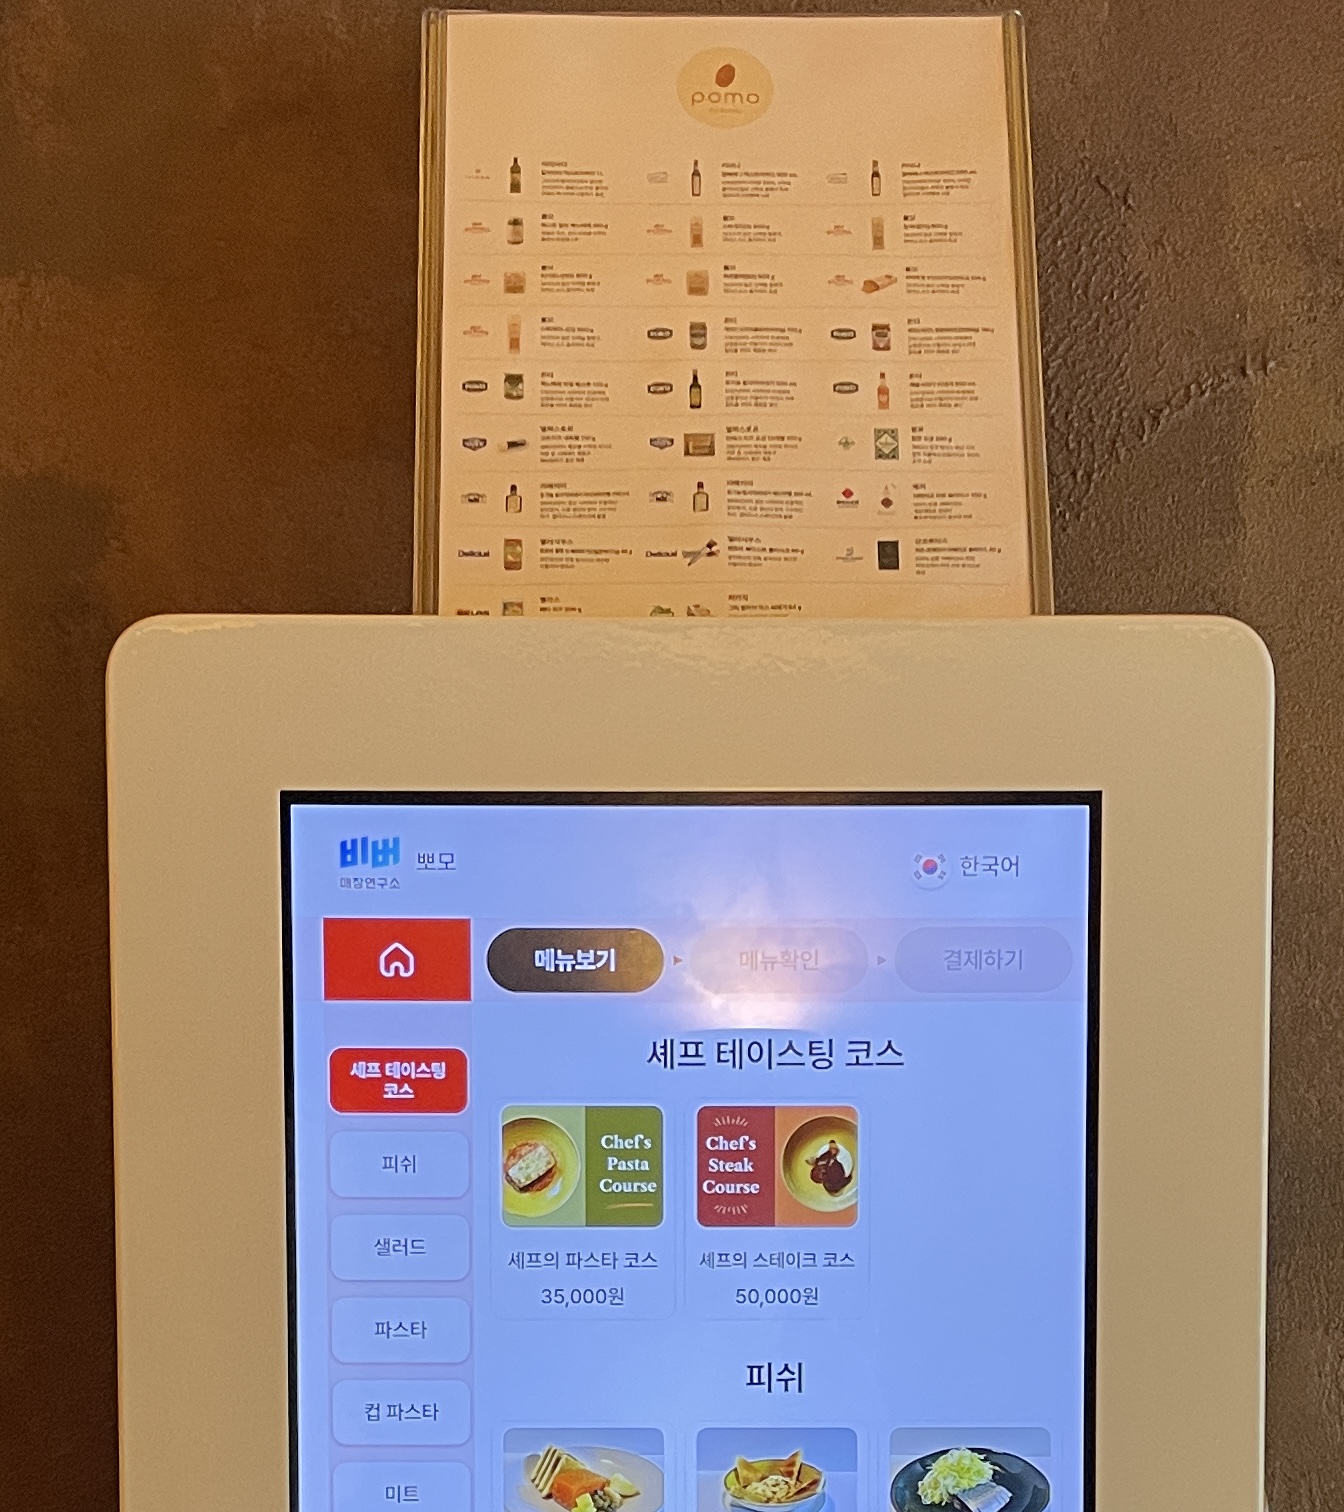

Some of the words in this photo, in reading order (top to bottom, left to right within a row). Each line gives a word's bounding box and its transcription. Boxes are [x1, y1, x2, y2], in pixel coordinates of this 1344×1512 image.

[691, 91, 760, 106] pomo
[339, 836, 401, 868] 비버
[416, 852, 457, 871] 뽀모
[960, 854, 1020, 879] 한국어
[533, 947, 616, 973] 메뉴보기
[739, 947, 820, 973] 메뉴확인
[943, 947, 1024, 973] 결제하기
[716, 1036, 835, 1072] 테이스팅
[845, 1039, 905, 1069] 코스
[385, 1061, 447, 1080] 테이스팅
[383, 1083, 415, 1099] 코스
[601, 1134, 652, 1150] Chef's
[705, 1136, 757, 1152] Chef's
[381, 1153, 418, 1175] 피쉬
[607, 1156, 650, 1172] Pasta
[708, 1158, 754, 1173] Steak
[599, 1178, 657, 1194] Course
[702, 1180, 760, 1195] Course
[374, 1237, 427, 1258] 샐러드
[565, 1251, 619, 1270] 파스타
[623, 1253, 659, 1270] 코스
[752, 1251, 818, 1270] 스테이크
[822, 1253, 857, 1270] 코스
[541, 1287, 625, 1309] 35,000원
[735, 1287, 819, 1309] 50,000원
[374, 1318, 427, 1340] 파스타
[745, 1361, 805, 1394] 피쉬
[363, 1401, 381, 1423] 컵
[385, 1401, 439, 1423] 파스타
[384, 1483, 420, 1505] 미트
